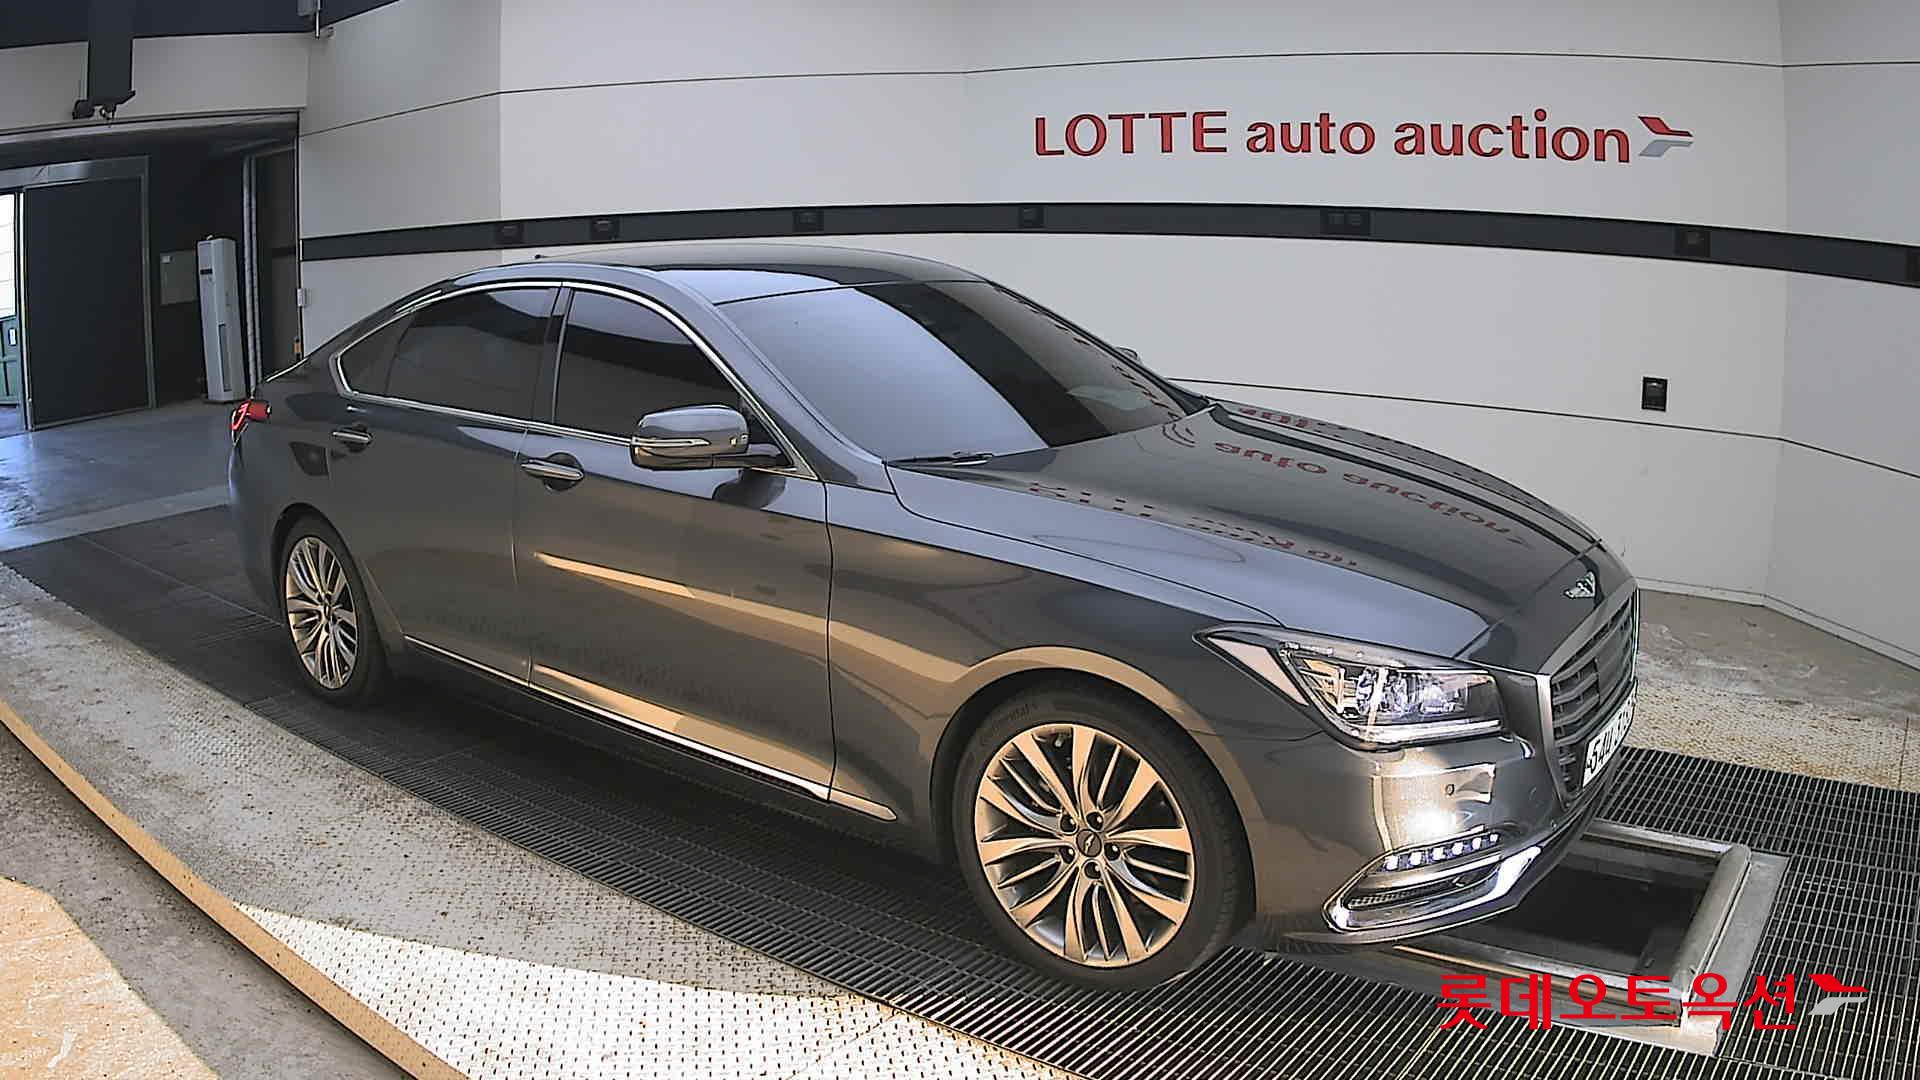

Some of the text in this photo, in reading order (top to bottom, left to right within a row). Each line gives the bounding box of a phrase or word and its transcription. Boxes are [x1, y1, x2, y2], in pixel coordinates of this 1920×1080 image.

[1035, 108, 1631, 163] LOTTE auto auction
